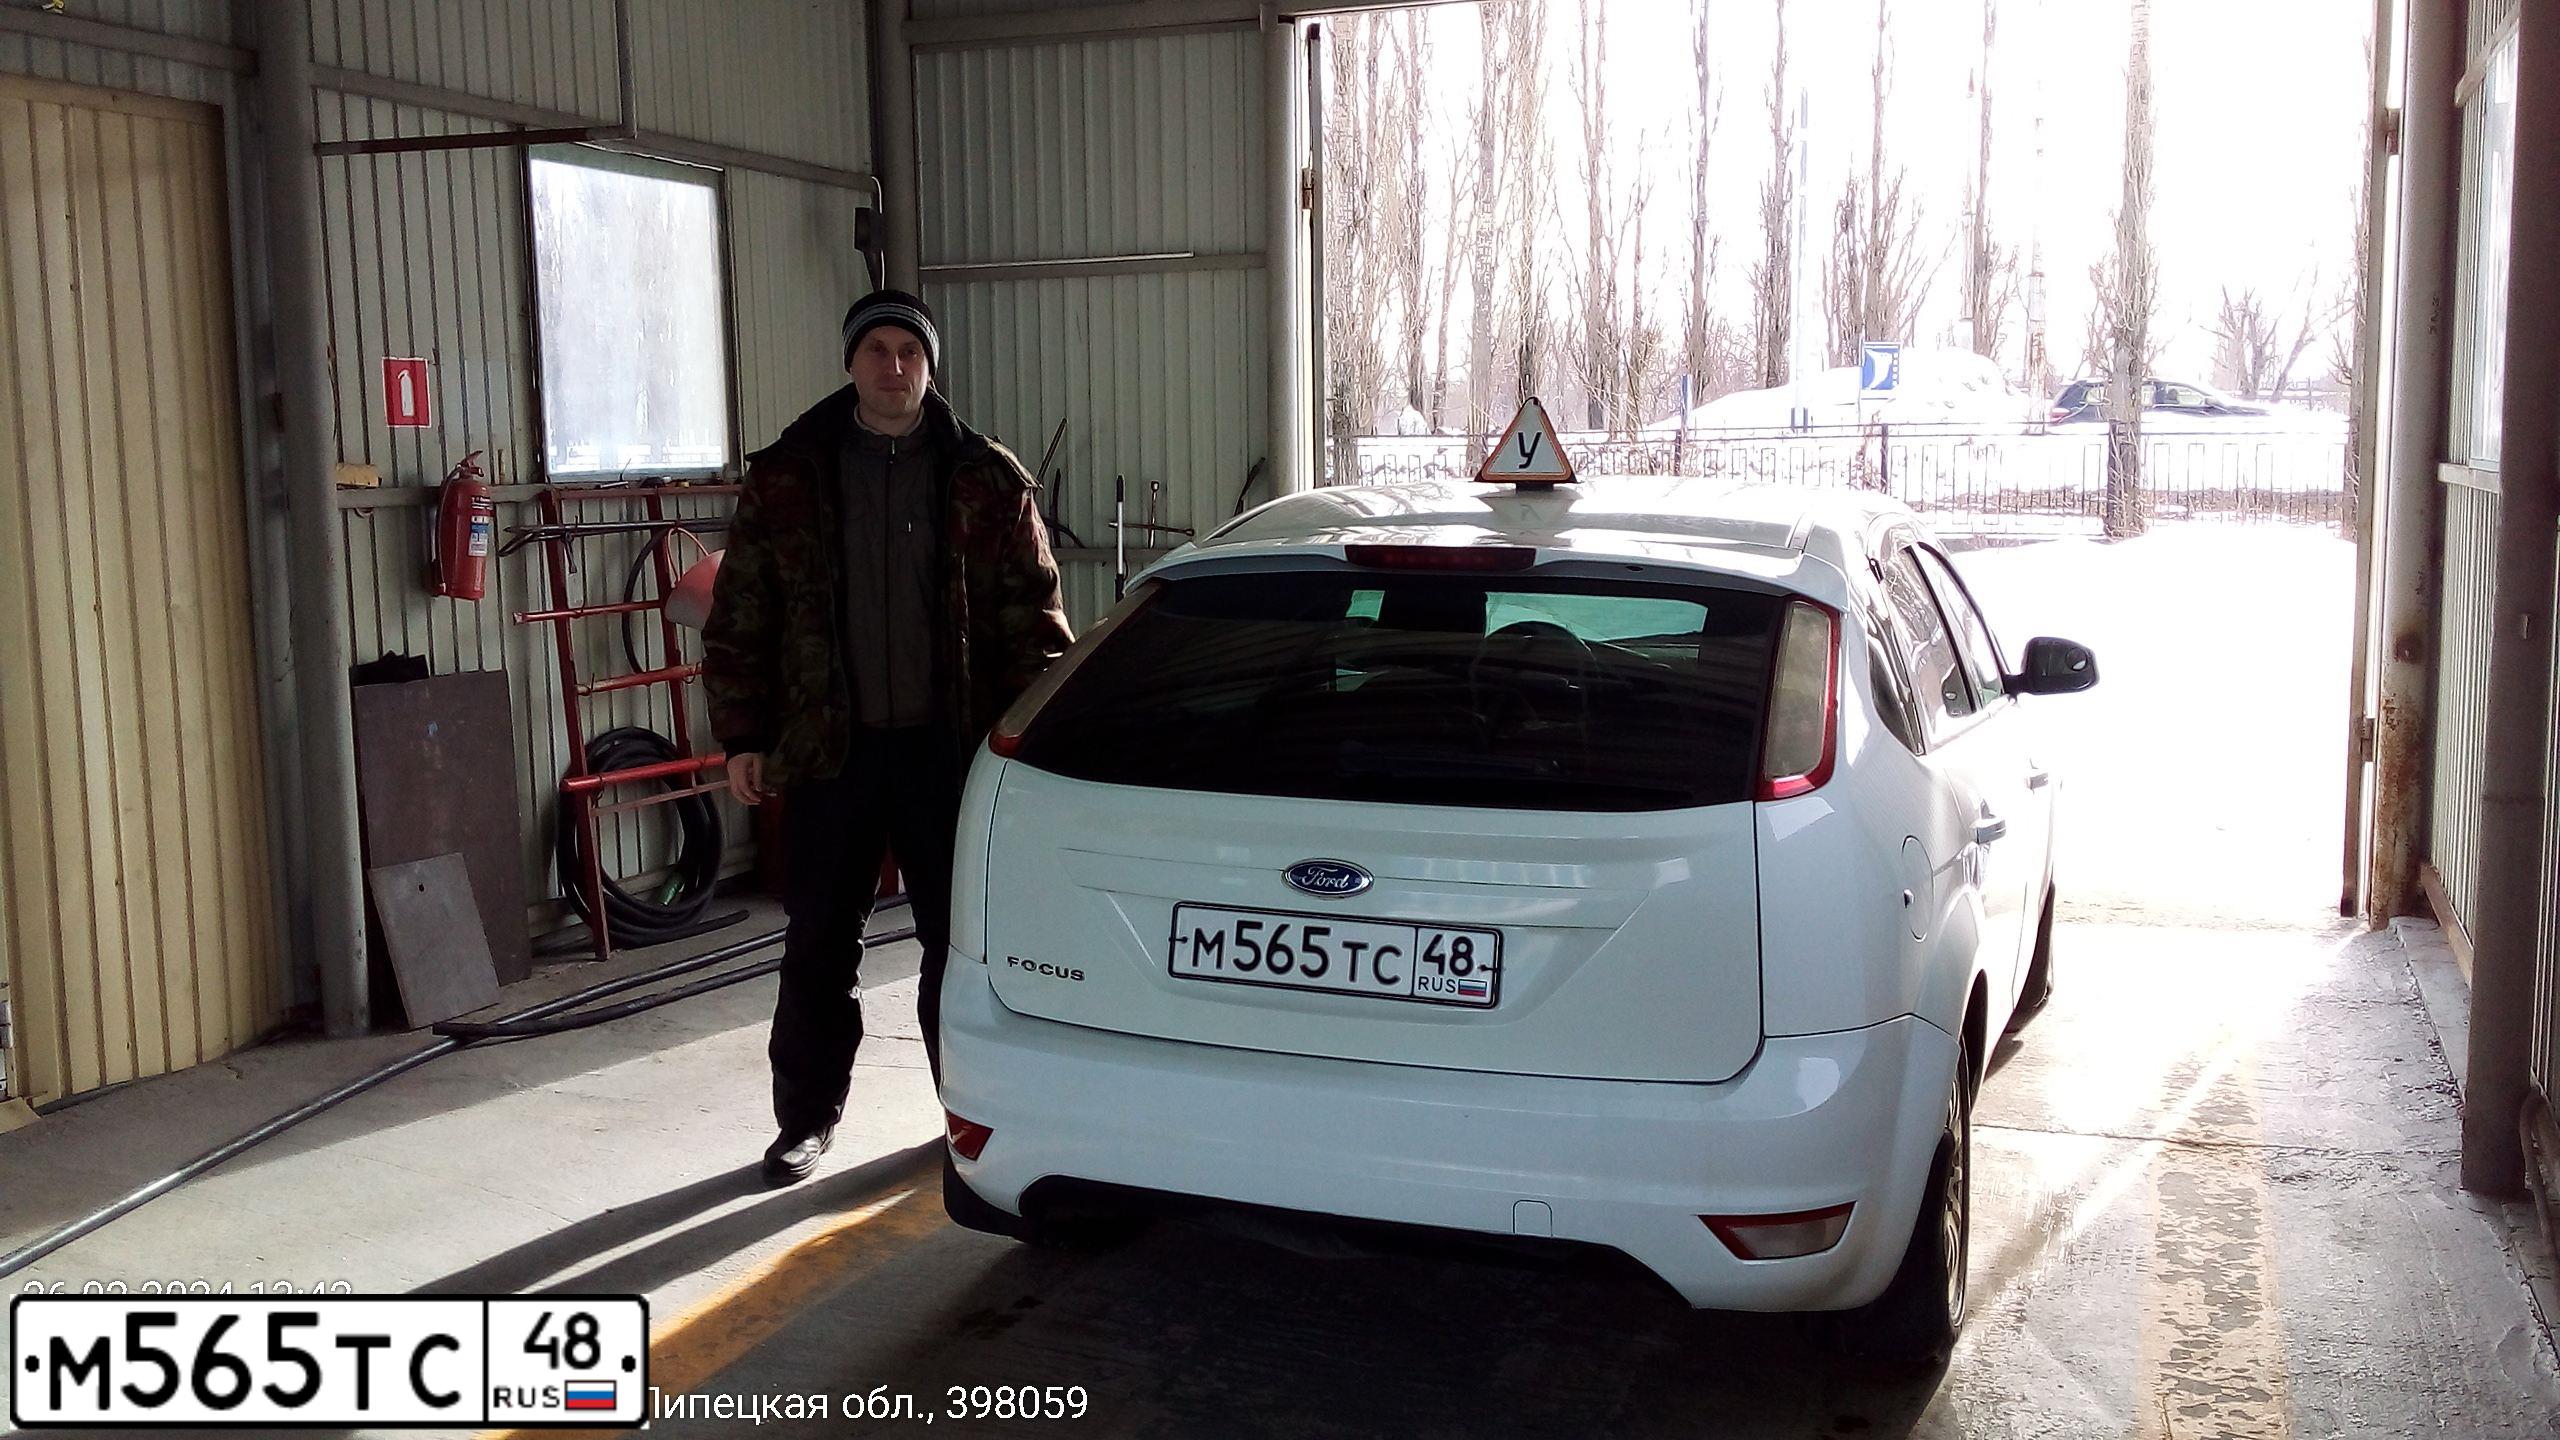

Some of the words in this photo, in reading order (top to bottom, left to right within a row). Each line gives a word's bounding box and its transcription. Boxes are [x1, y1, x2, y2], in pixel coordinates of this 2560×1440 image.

[1301, 865, 1351, 889] Ford
[1421, 933, 1475, 977] 48
[1006, 955, 1086, 981] FOCUS
[1417, 976, 1457, 994] RUS
